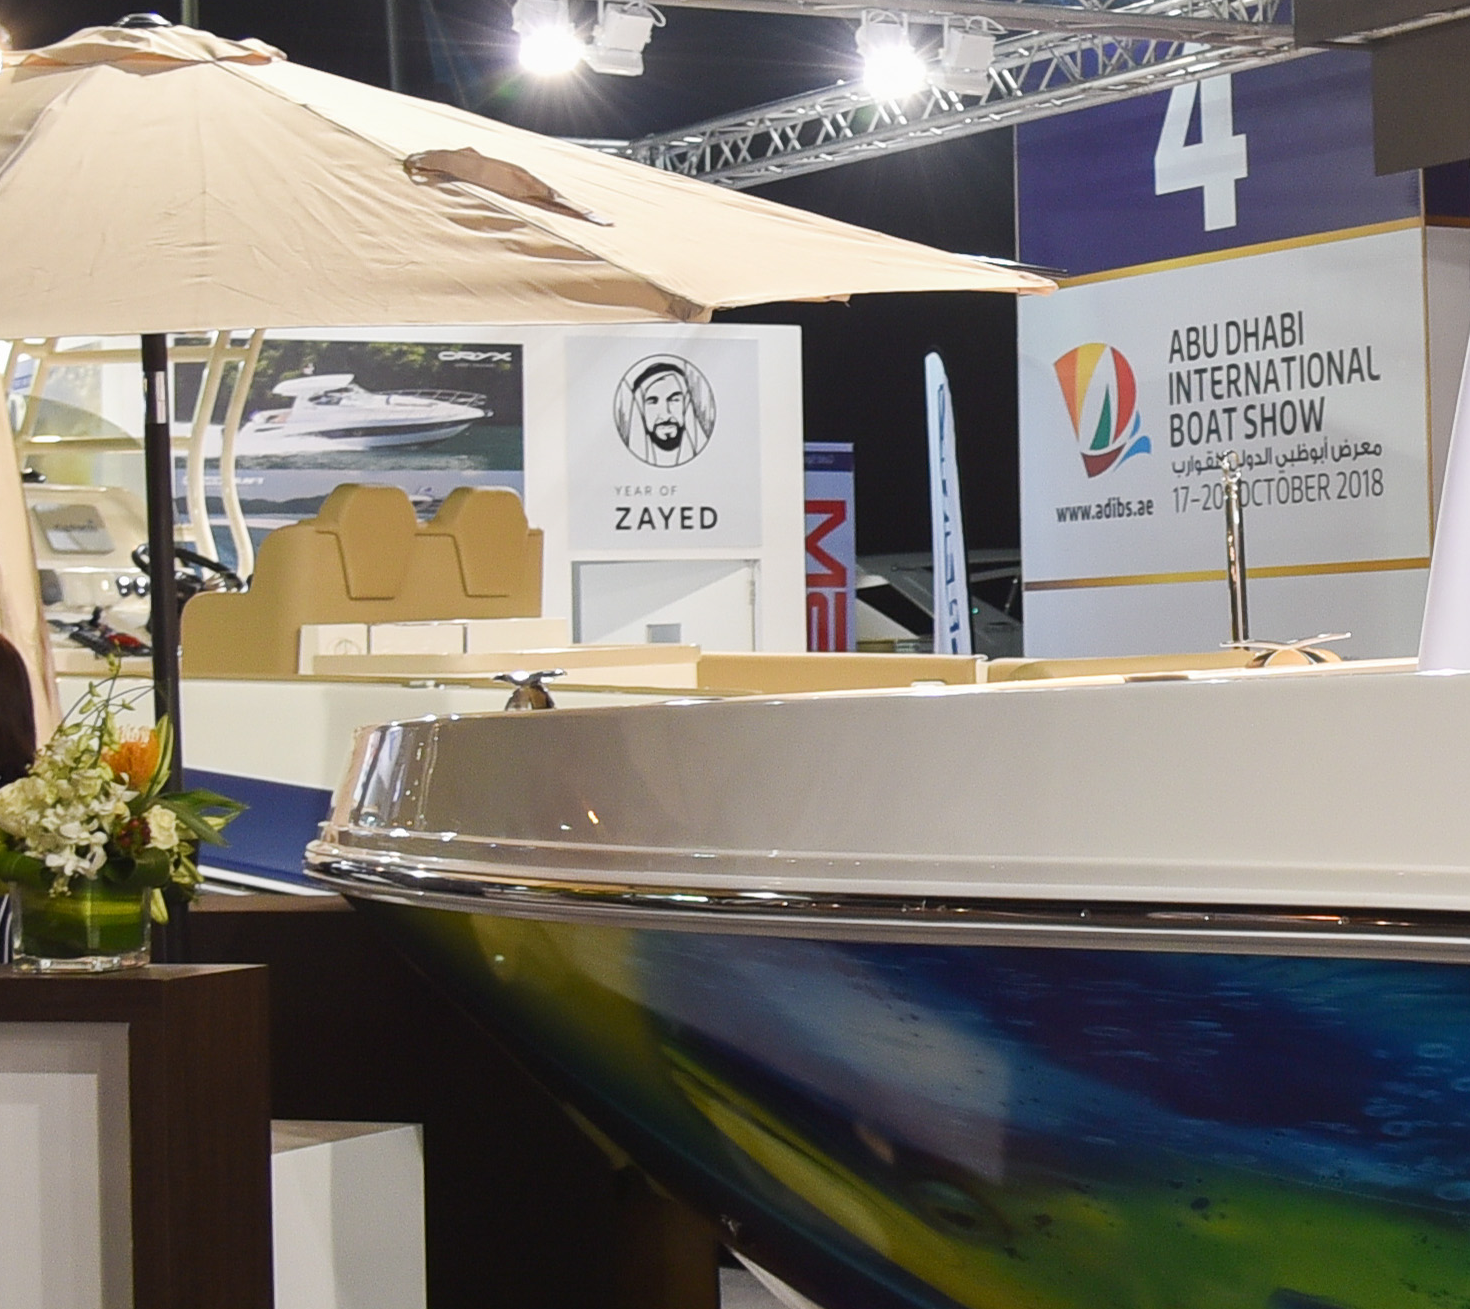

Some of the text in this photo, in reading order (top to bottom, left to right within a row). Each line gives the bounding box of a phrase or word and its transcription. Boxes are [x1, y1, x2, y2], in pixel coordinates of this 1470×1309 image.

[1154, 42, 1248, 232] 4
[1168, 311, 1304, 363] ABU DHABI
[438, 351, 512, 361] ORYX
[1168, 345, 1382, 405] INTERNATIONAL
[1169, 396, 1326, 448] BOAT SHOW
[1233, 447, 1273, 472] الدول
[1330, 440, 1383, 464] معرض
[614, 485, 678, 497] YEAR OF
[1336, 467, 1385, 500] 2018
[615, 506, 719, 530] ZAYED
[1055, 496, 1155, 523] www.adibs.ae
